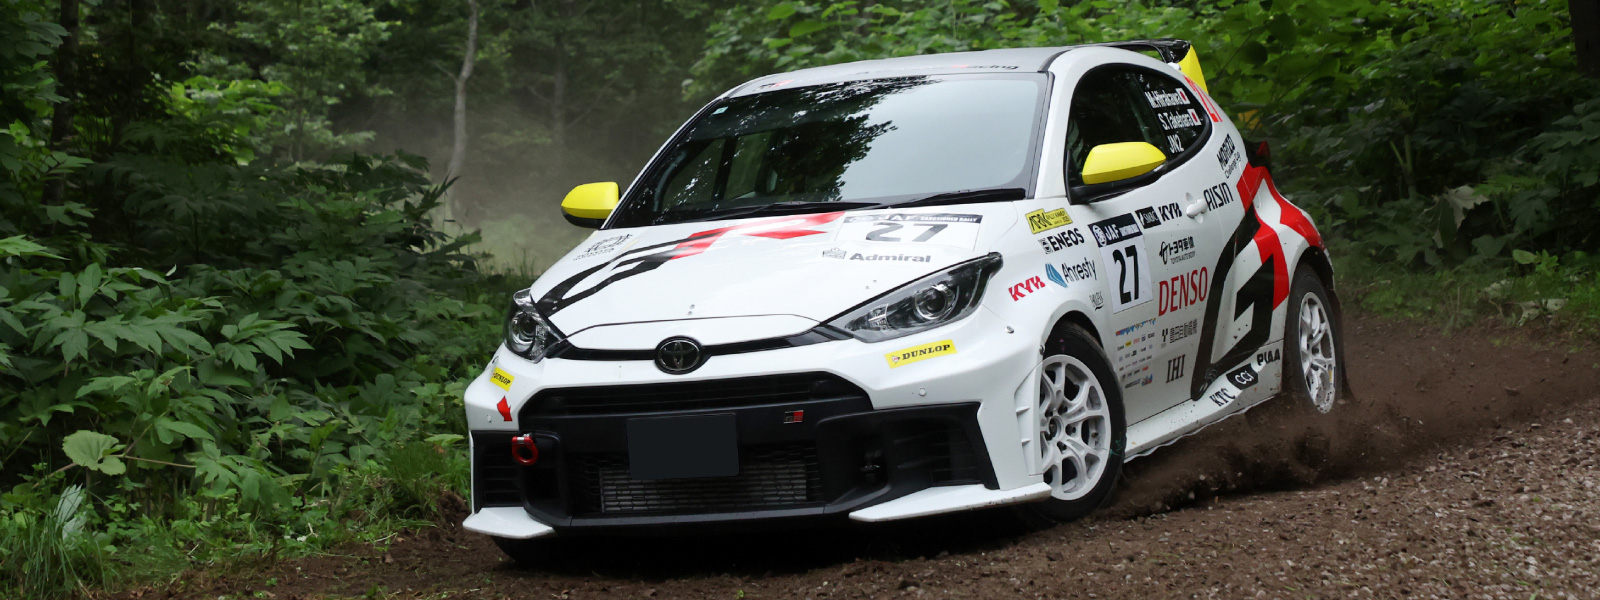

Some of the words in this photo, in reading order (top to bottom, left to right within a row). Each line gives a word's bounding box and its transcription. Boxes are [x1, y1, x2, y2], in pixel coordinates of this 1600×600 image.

[1167, 134, 1184, 153] JN2
[1203, 182, 1234, 211] AISIN
[1158, 202, 1182, 221] KYB
[866, 222, 948, 242] 27
[1046, 228, 1085, 252] ENEOS
[1104, 224, 1119, 241] JAF
[850, 252, 931, 263] Admiral
[1061, 257, 1097, 283] Ahresty
[1112, 245, 1139, 305] 27
[1008, 275, 1046, 302] KYB
[1158, 266, 1208, 317] DENSO
[902, 344, 950, 360] DUNLOP
[1257, 348, 1281, 366] PIAA
[493, 372, 511, 385] DUNLOP
[1165, 354, 1186, 384] IHI
[1209, 387, 1236, 407] KTC
